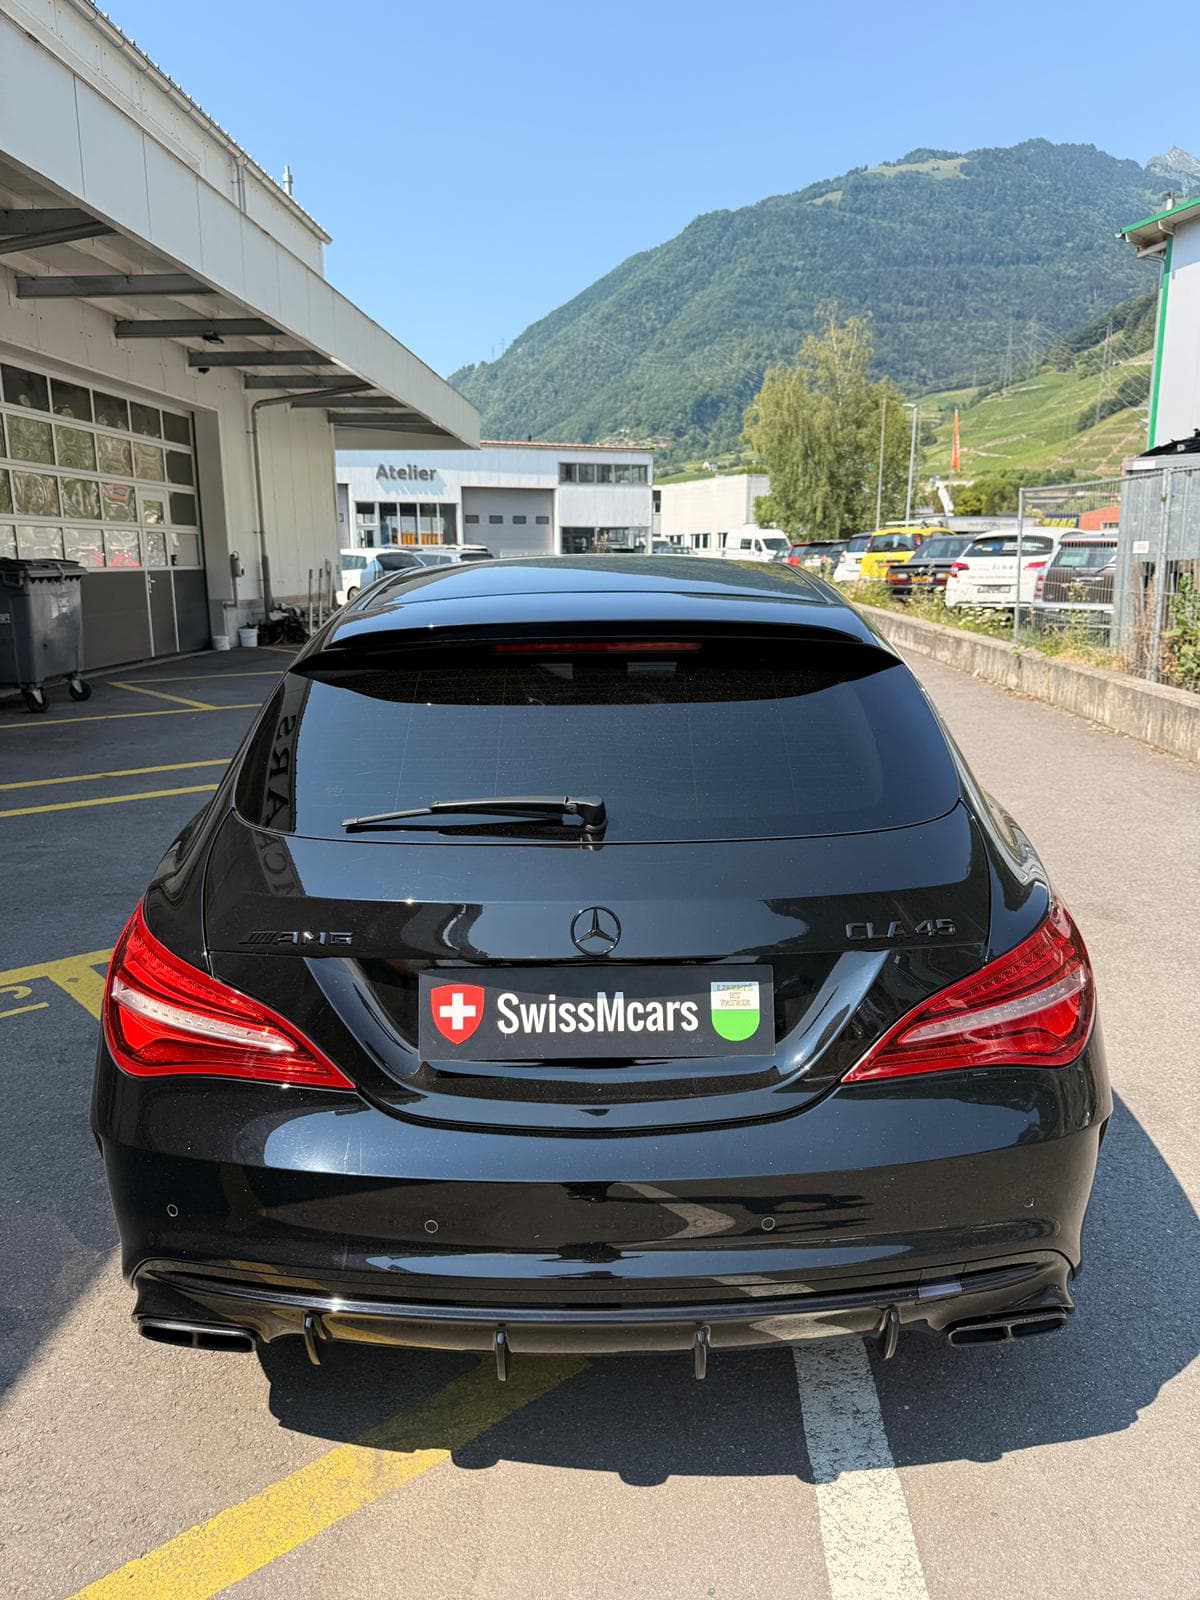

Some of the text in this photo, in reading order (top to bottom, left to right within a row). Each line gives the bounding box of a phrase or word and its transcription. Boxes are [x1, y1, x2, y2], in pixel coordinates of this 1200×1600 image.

[375, 463, 437, 481] Atelier
[277, 930, 353, 945] AMG
[845, 918, 957, 939] CLA 45
[496, 991, 699, 1034] SwissMcars
